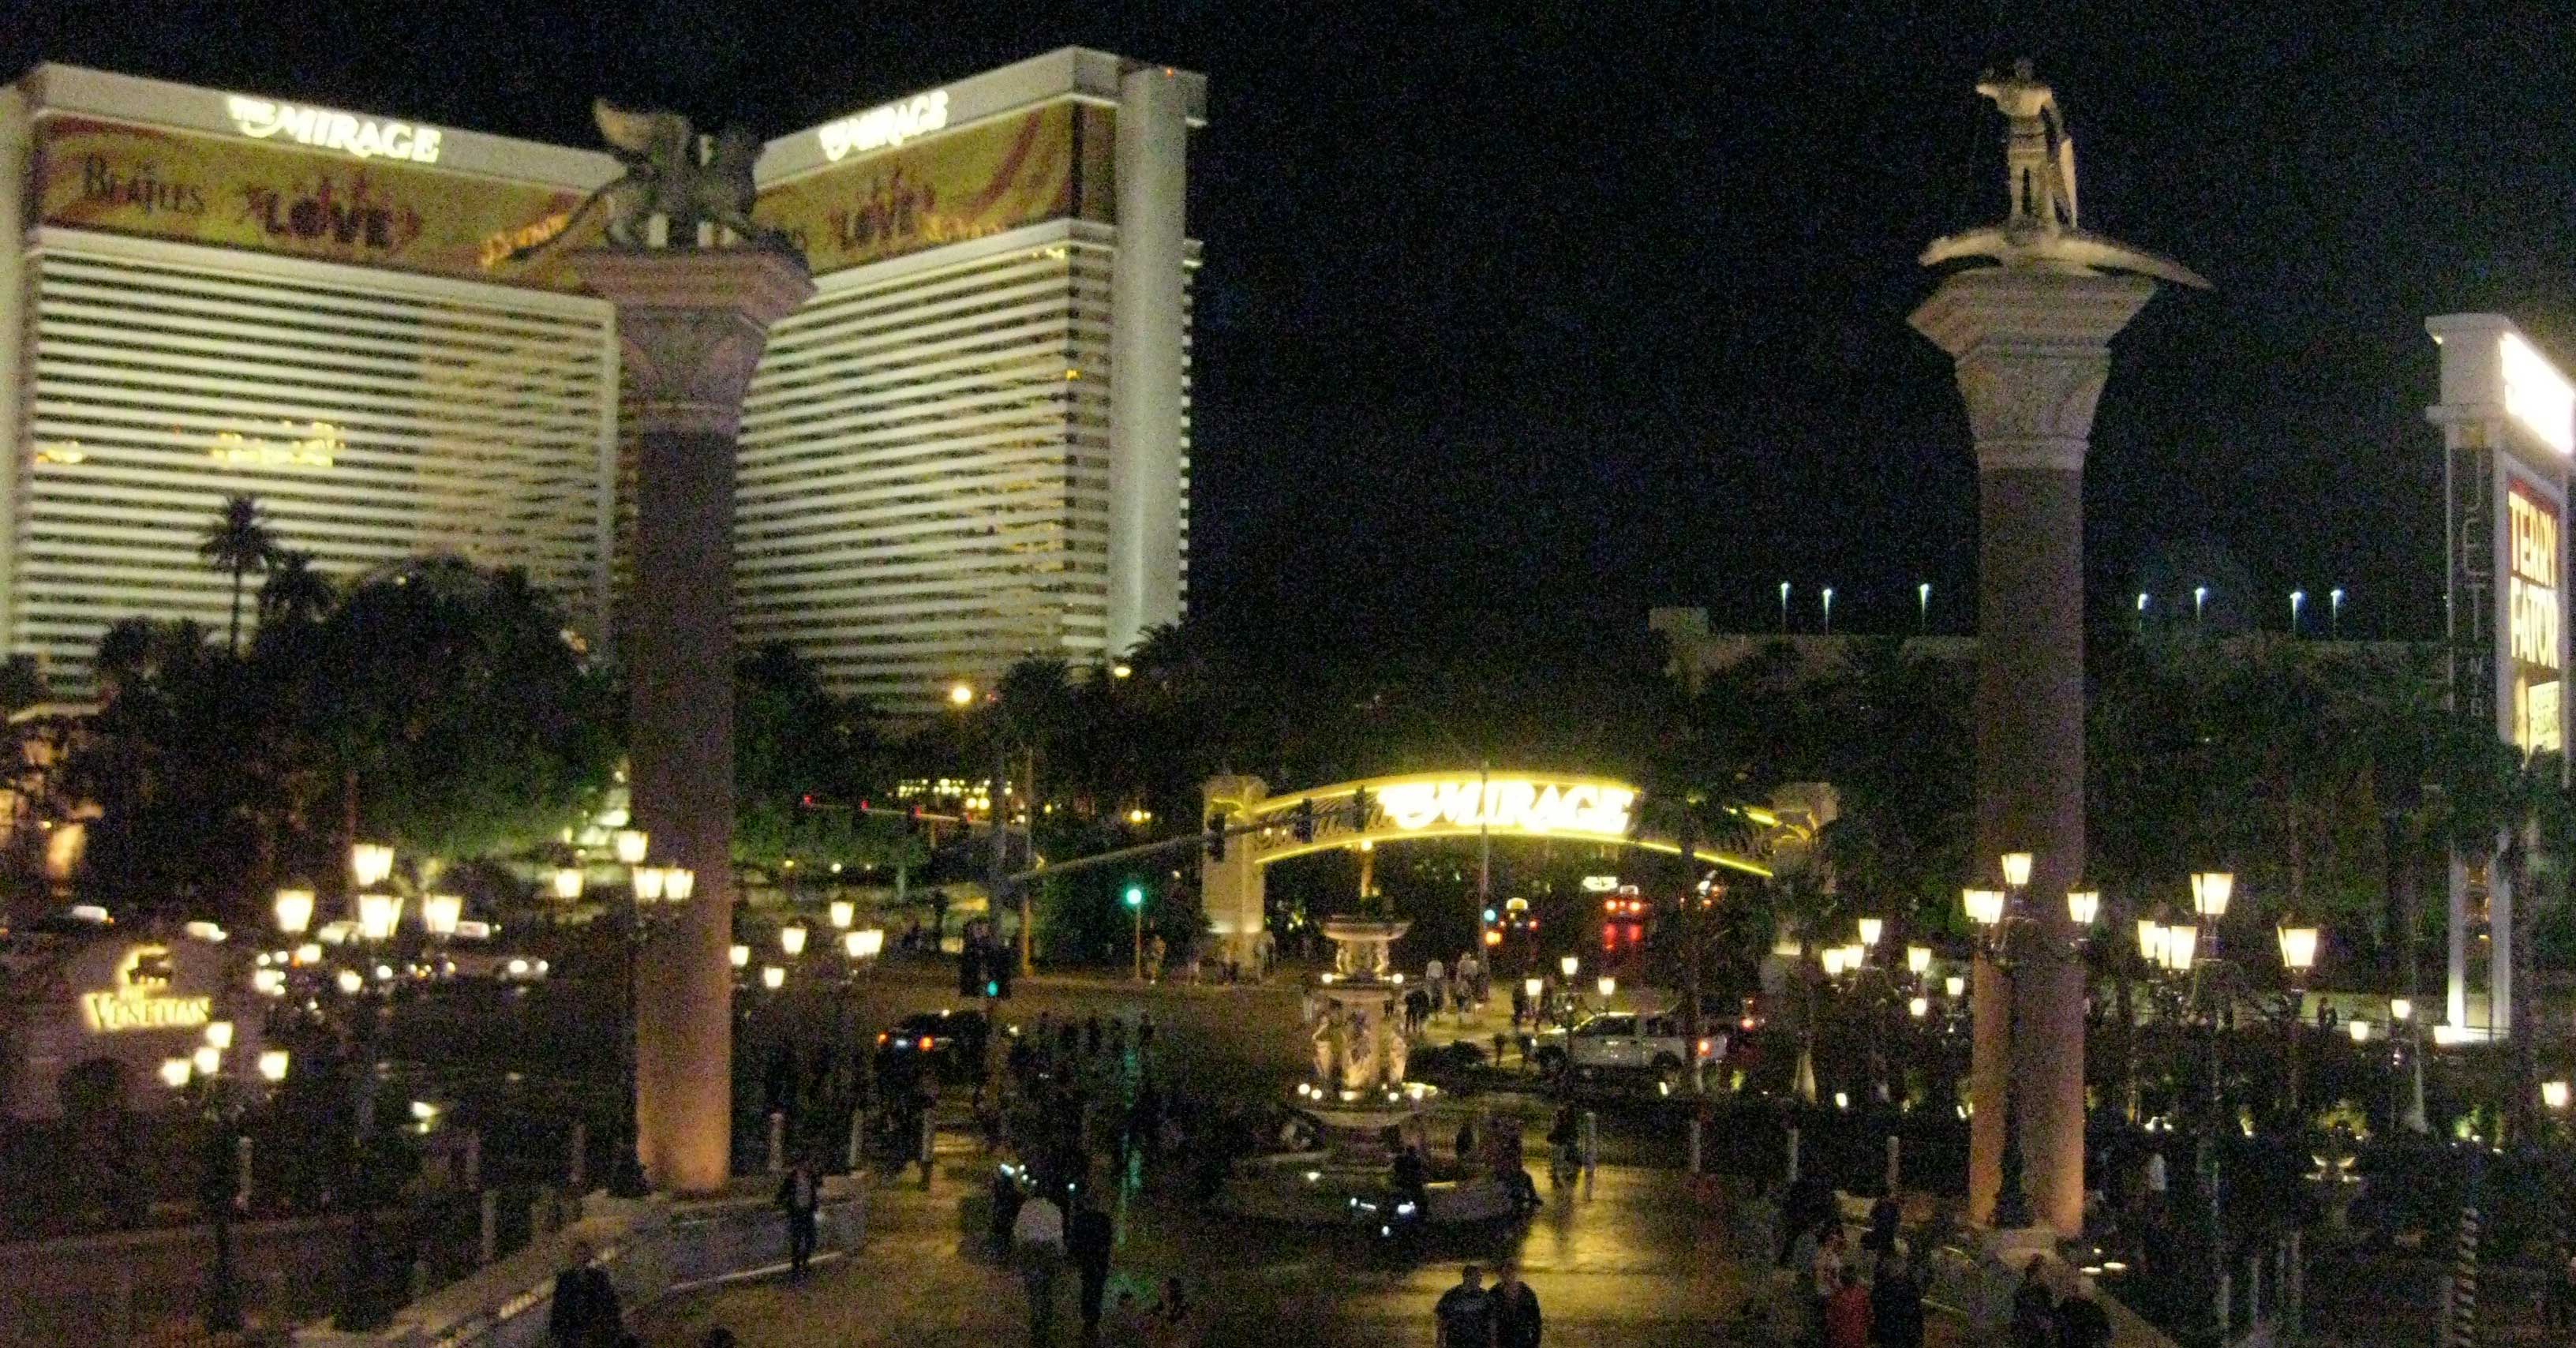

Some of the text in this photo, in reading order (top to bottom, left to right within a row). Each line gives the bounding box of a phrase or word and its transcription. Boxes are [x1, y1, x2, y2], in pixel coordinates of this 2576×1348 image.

[242, 106, 442, 163] MIRAGE
[2508, 490, 2558, 588] TERRY
[2510, 575, 2559, 670] FATOR
[1398, 781, 1633, 834] MIRAGE
[82, 992, 211, 1031] VENETIAN
